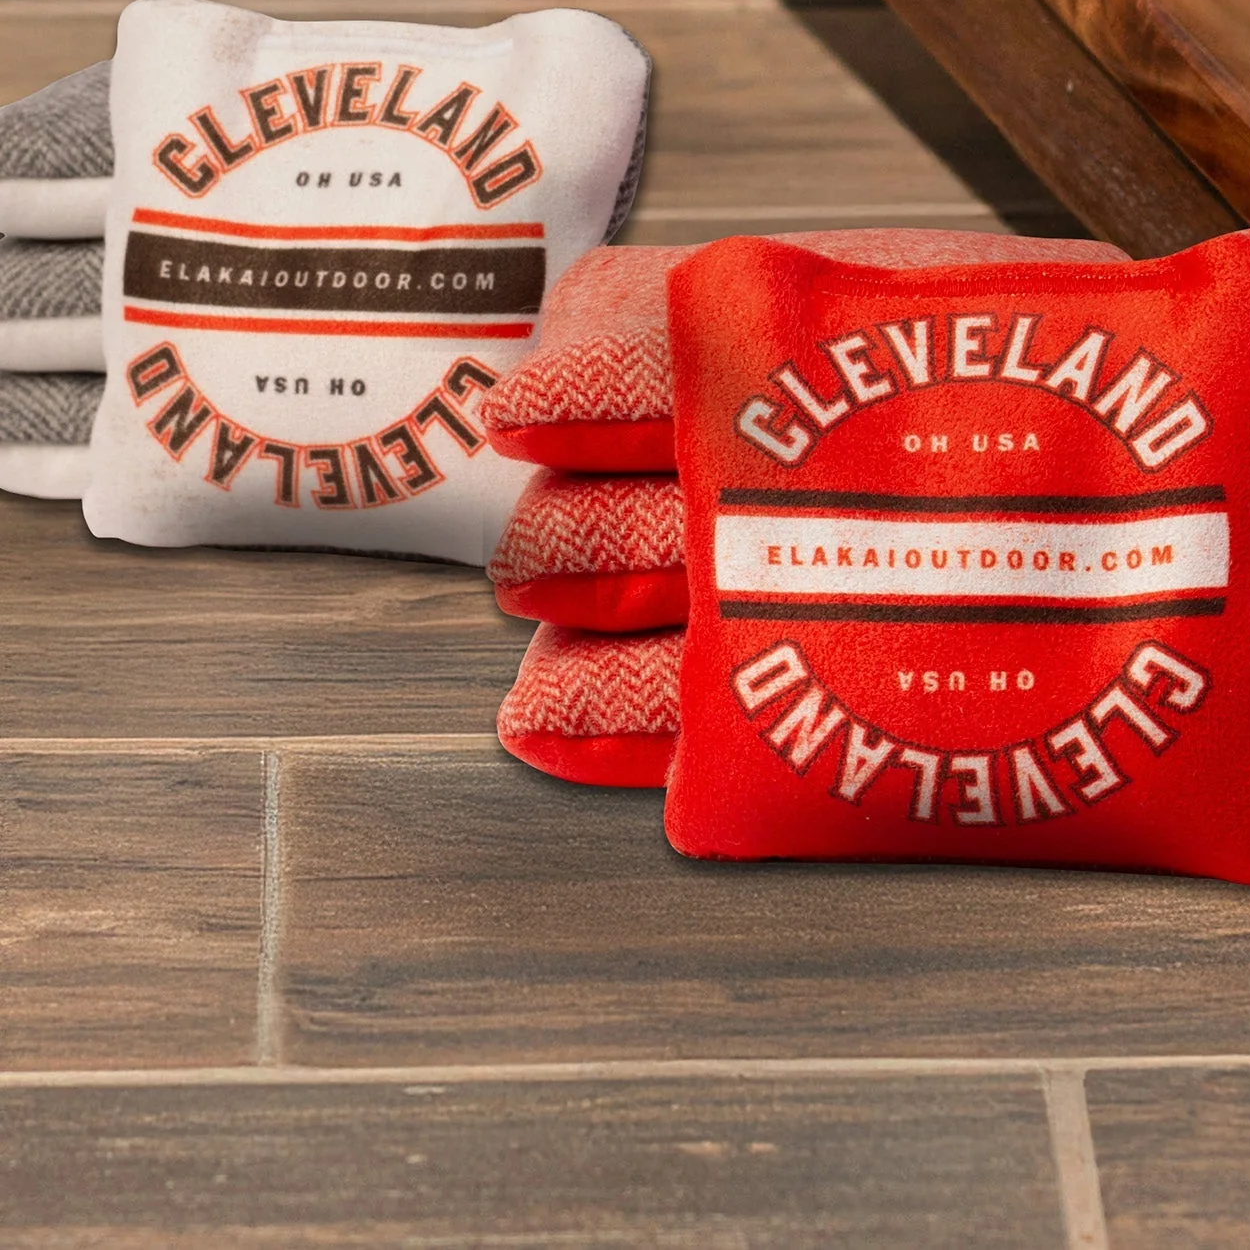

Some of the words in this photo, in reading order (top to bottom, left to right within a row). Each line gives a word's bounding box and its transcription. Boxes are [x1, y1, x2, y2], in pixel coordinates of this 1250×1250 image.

[152, 62, 544, 211] CLEVELAND
[295, 171, 332, 188] OH
[349, 171, 404, 189] USA
[158, 259, 497, 292] ELAKAIOUTDOOR.COM
[255, 375, 310, 395] USA
[328, 376, 367, 397] OH
[733, 311, 1216, 475] CLEVELAND
[903, 434, 950, 453] OH
[971, 432, 1041, 452] USA
[767, 543, 1175, 573] ELAKAIOUTDOOR.COM
[898, 670, 966, 690] USA
[989, 670, 1035, 691] OH
[729, 639, 1213, 827] CLEVELAND
